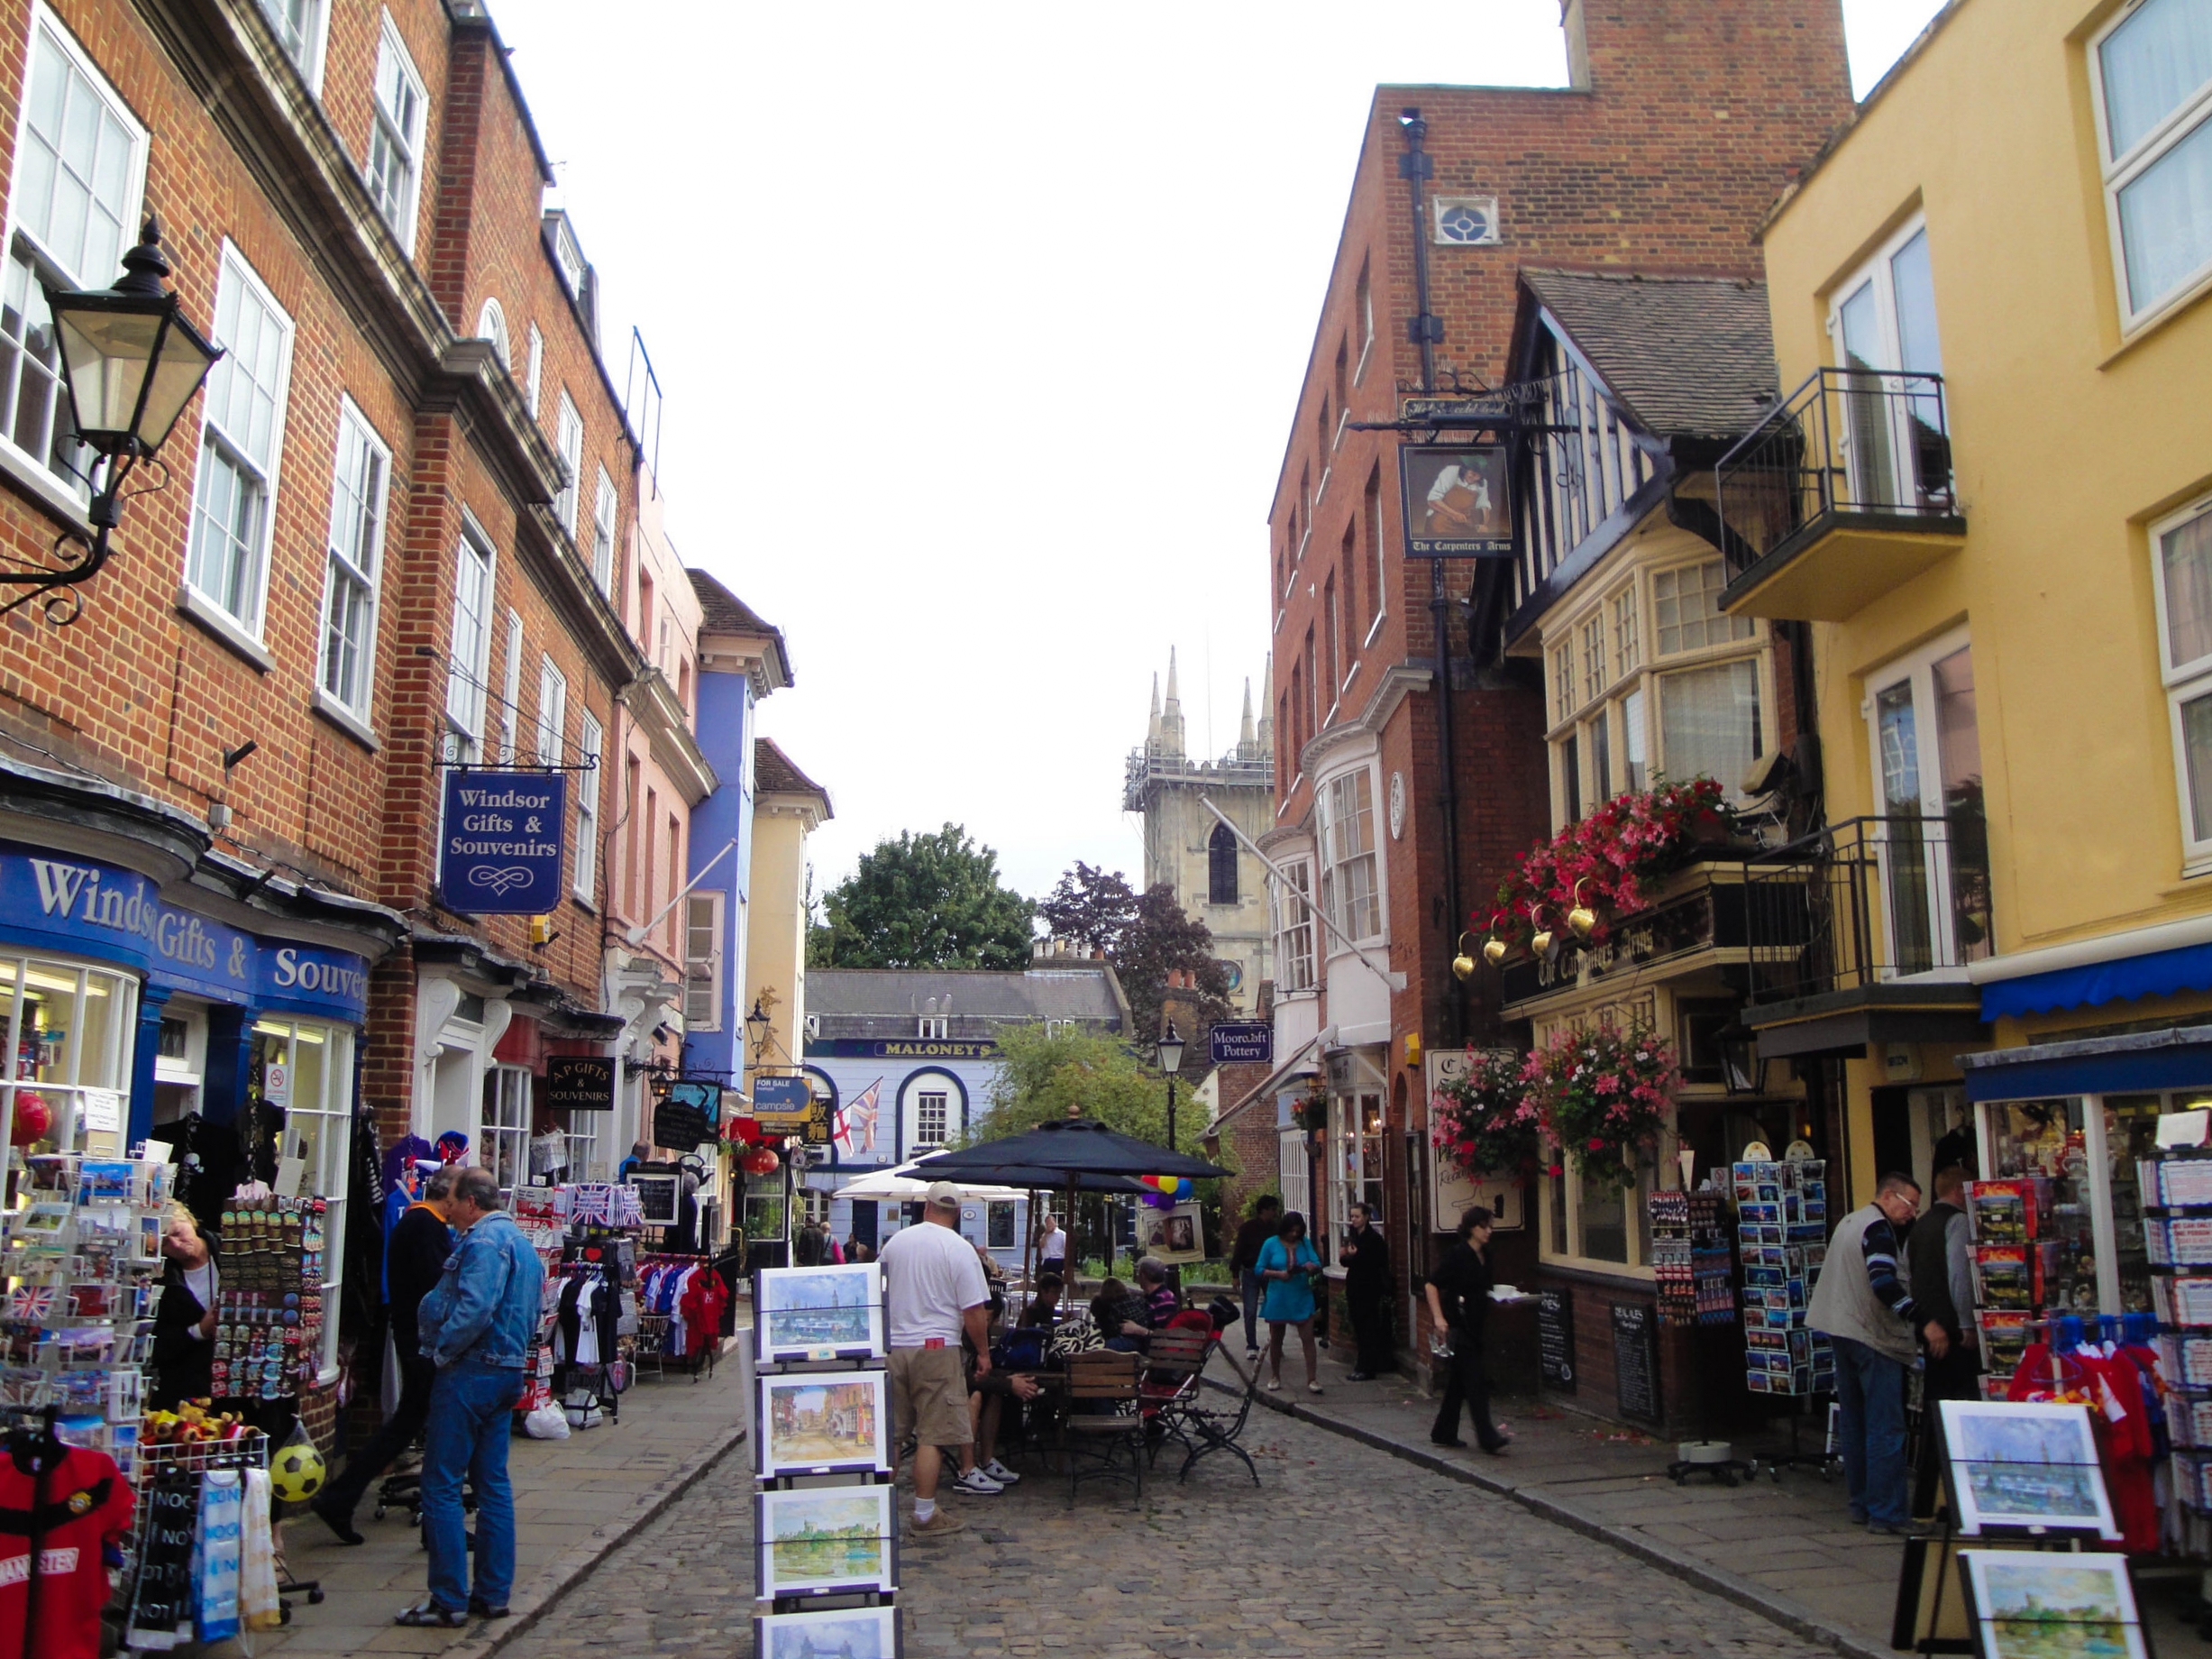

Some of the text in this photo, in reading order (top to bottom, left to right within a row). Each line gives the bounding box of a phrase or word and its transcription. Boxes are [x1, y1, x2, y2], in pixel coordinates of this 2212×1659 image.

[1412, 541, 1512, 552] The Carpenters Arms
[458, 789, 551, 809] Windsor
[462, 813, 543, 833] Gifts &
[450, 837, 557, 857] Souvenirs
[157, 912, 216, 970] Gifts
[227, 936, 246, 980] &
[1213, 1031, 1266, 1044] Moorcoft
[885, 1043, 992, 1057] MALONEY'S
[1222, 1044, 1261, 1058] Pottery
[553, 1062, 609, 1083] A P GIFTS
[577, 1078, 585, 1087] &
[549, 1090, 609, 1101] SOUVENIRS
[755, 1098, 795, 1112] campsie
[575, 1246, 584, 1260] I
